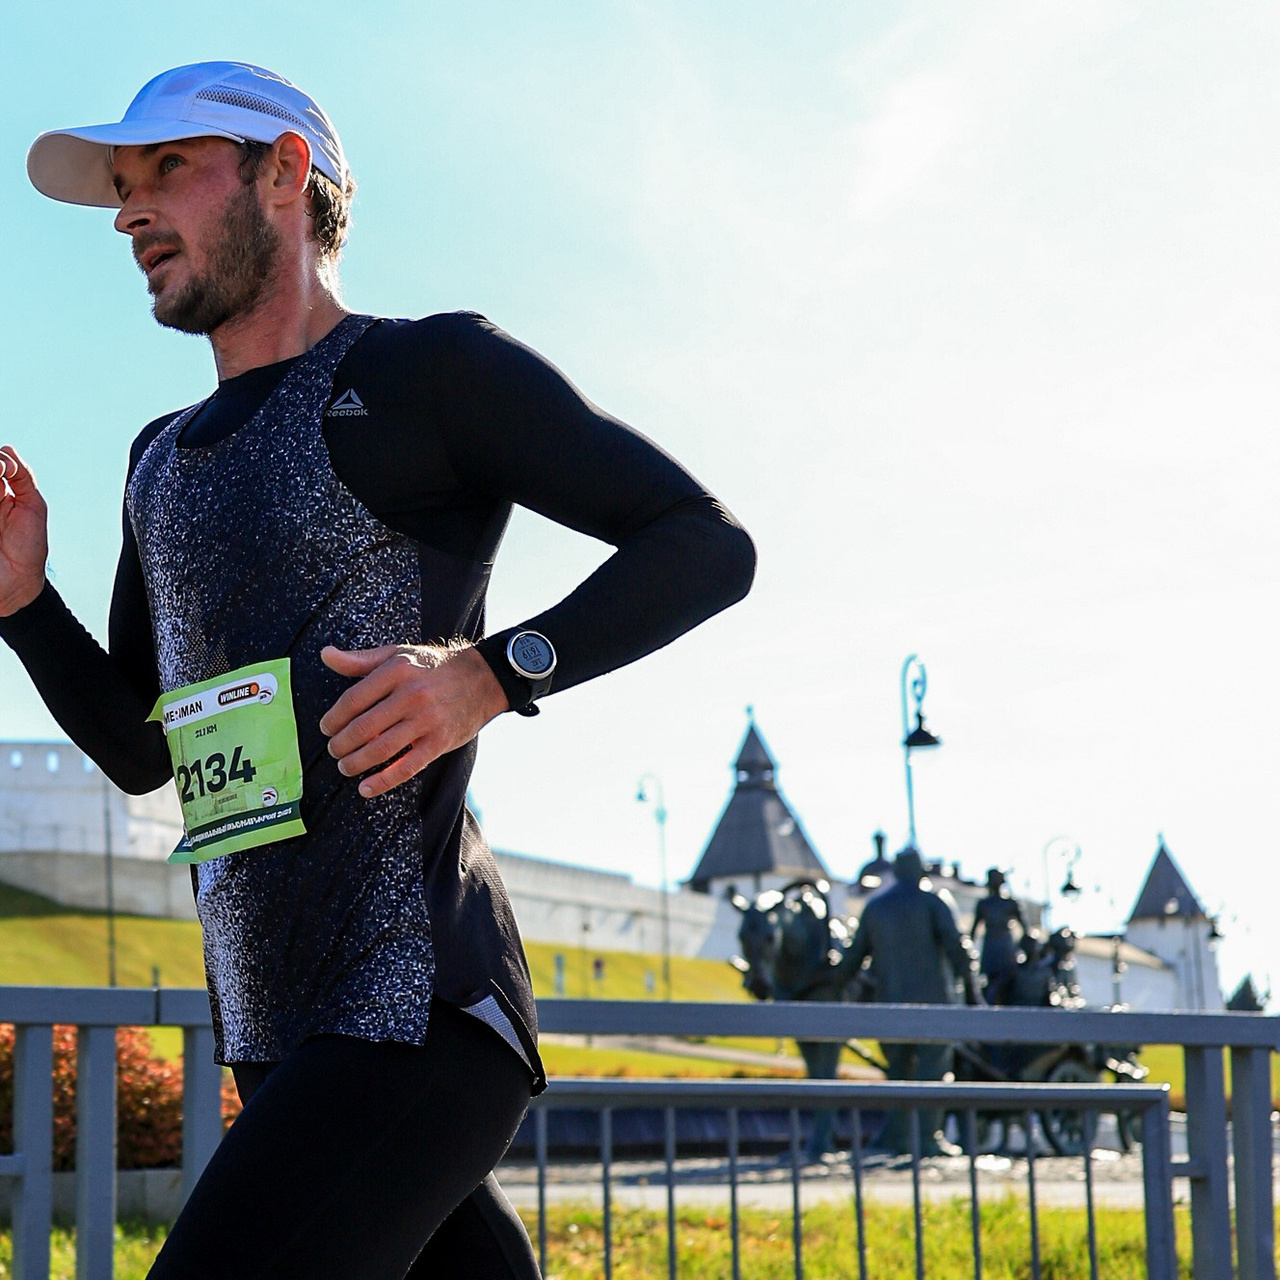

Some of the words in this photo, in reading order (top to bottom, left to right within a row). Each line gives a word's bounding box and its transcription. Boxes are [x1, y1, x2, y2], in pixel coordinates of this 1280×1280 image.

[324, 407, 369, 418] Reebok
[220, 686, 250, 704] WINLINE
[177, 746, 257, 804] 2134
